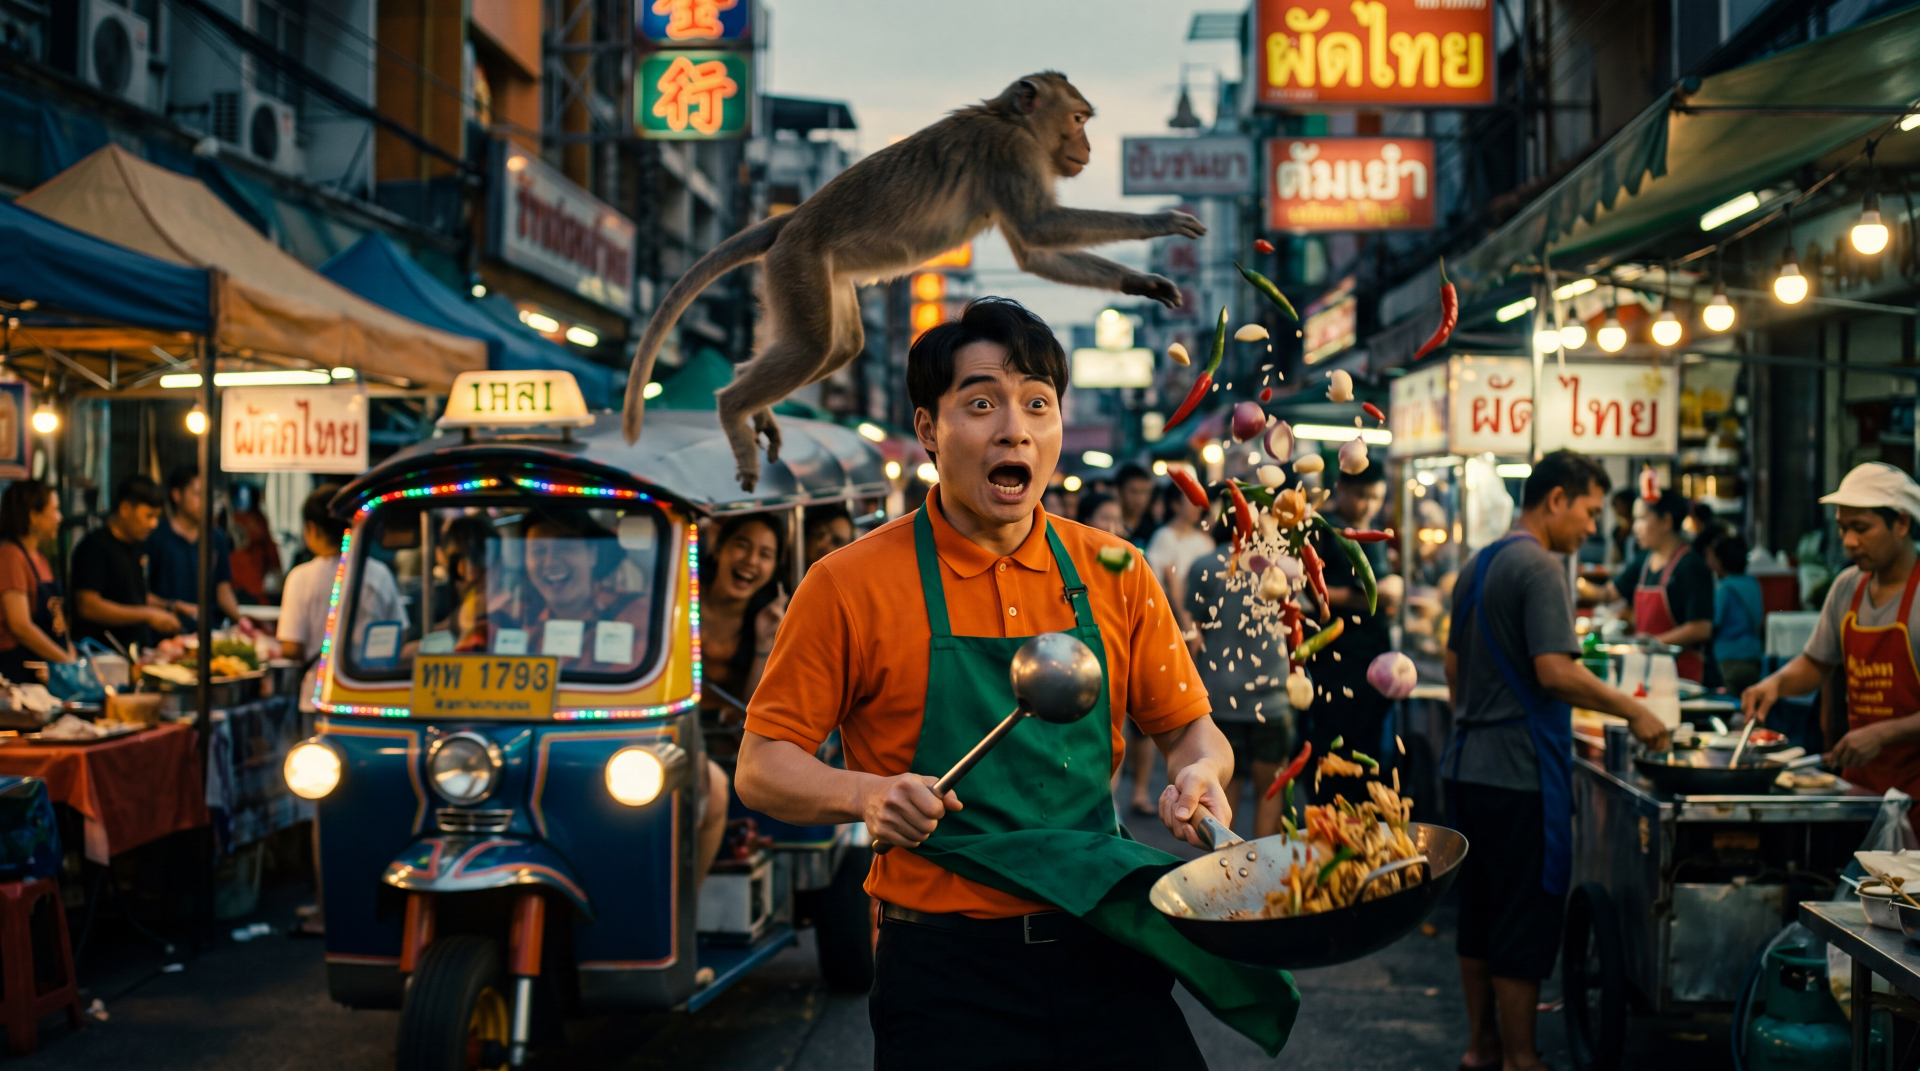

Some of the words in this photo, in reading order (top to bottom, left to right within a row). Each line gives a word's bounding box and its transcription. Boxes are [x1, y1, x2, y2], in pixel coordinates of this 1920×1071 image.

[1266, 0, 1484, 88] ผัดไทย
[479, 661, 549, 691] 1793
